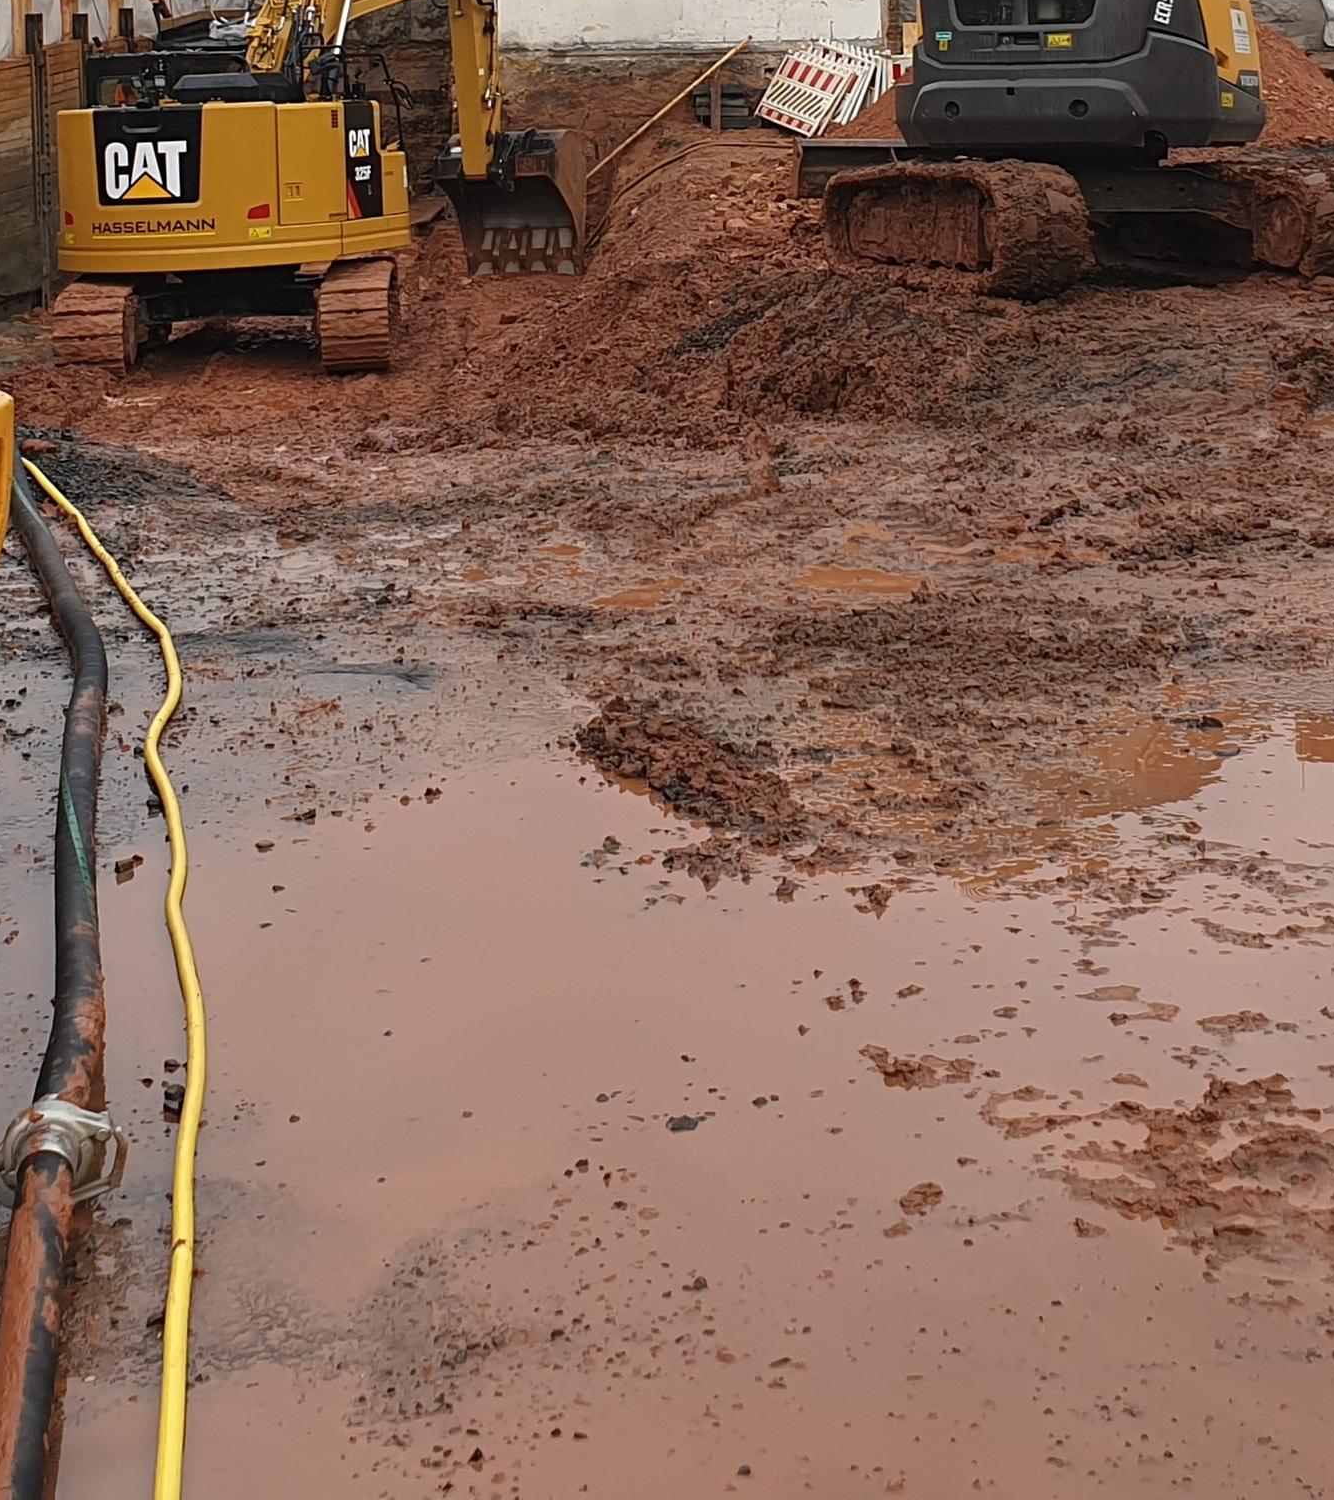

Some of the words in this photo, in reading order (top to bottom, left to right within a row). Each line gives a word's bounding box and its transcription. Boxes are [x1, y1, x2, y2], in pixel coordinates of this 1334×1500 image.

[349, 129, 371, 158] CAT
[104, 140, 187, 200] CAT
[354, 165, 372, 182] 325F
[92, 218, 216, 235] HASSELMANN
